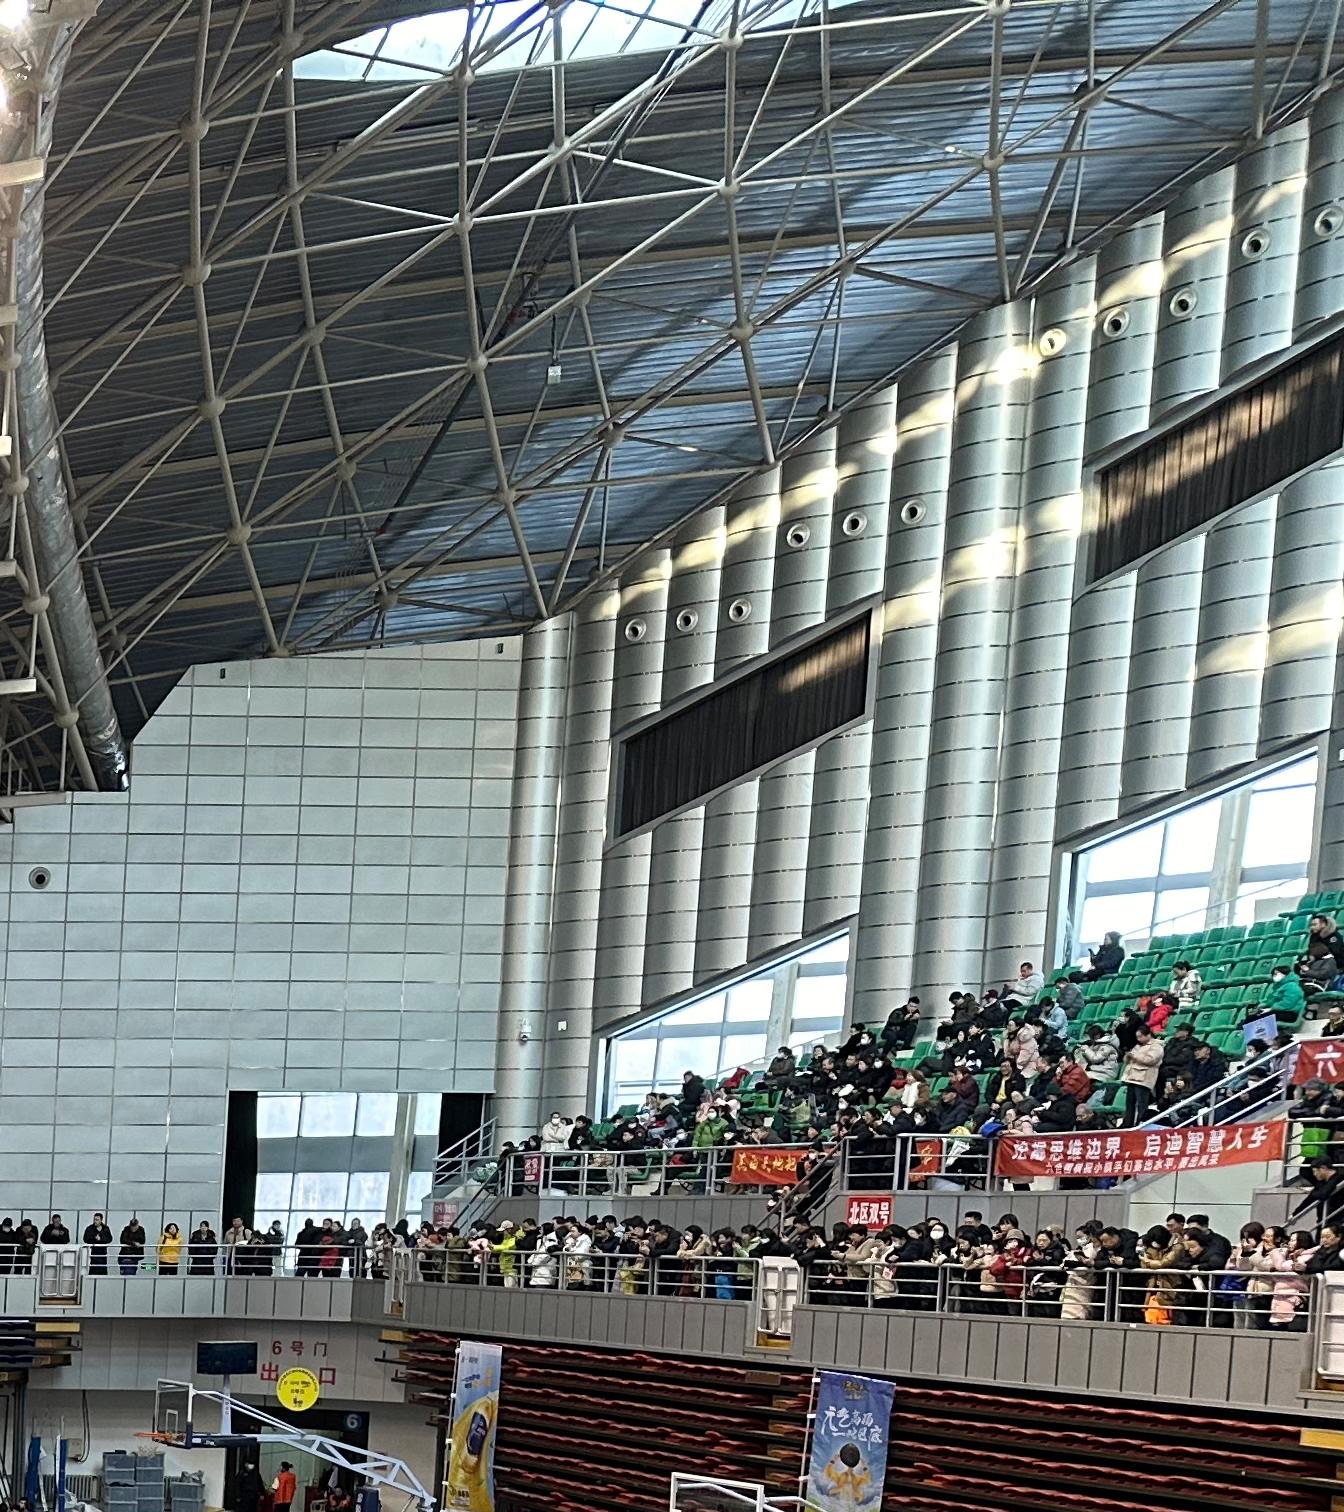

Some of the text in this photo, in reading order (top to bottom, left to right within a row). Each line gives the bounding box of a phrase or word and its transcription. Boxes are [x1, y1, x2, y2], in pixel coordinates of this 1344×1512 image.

[1314, 1044, 1342, 1078] 六
[848, 1201, 890, 1225] 北区双号
